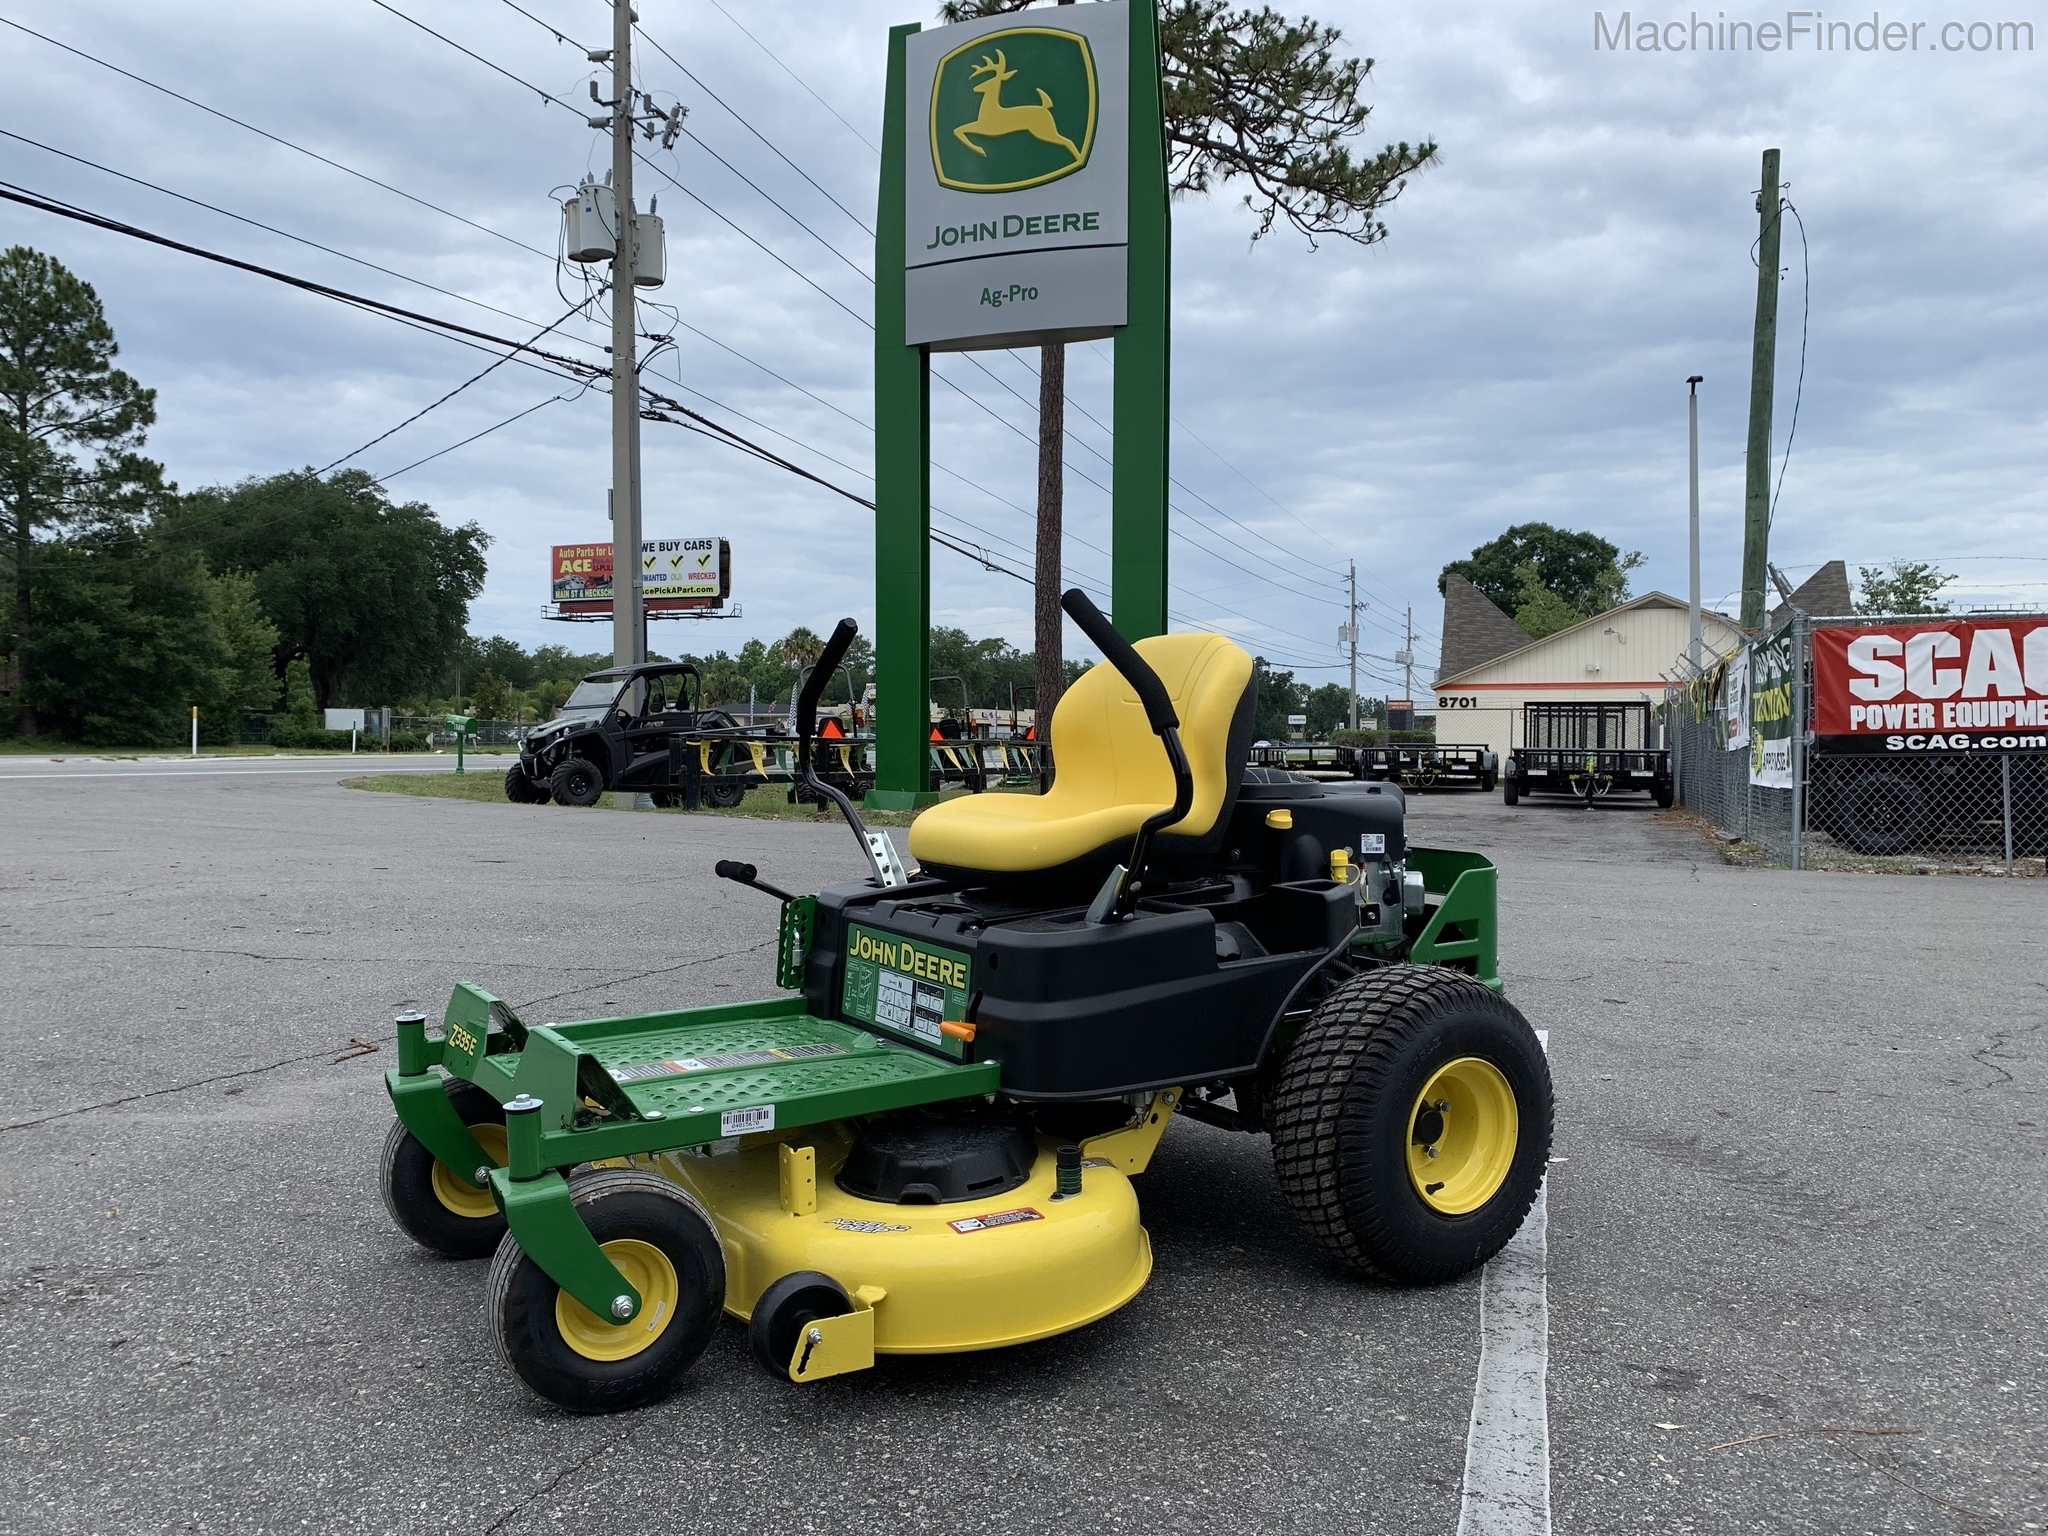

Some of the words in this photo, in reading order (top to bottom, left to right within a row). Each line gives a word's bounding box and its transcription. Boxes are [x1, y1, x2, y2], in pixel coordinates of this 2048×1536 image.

[927, 220, 997, 250] JOHN
[1003, 212, 1100, 238] DEERE
[980, 284, 1039, 307] Ag-Pro
[559, 548, 575, 558] Auto
[576, 547, 594, 557] Parts
[596, 546, 606, 556] for
[659, 541, 681, 552] BUY
[684, 540, 713, 551] CARS
[560, 558, 592, 573] ACE
[642, 573, 667, 582] WANTED
[671, 572, 682, 580] OLD
[688, 571, 717, 580] WRECKED
[555, 589, 570, 599] MAIN
[571, 589, 579, 598] ST
[1438, 696, 1477, 708] 8701
[1850, 702, 1936, 731] POWER
[1886, 734, 2047, 750] SCAG.com
[850, 930, 897, 968] JOHN
[900, 942, 967, 990] DEERE
[448, 1021, 478, 1057] Z335E
